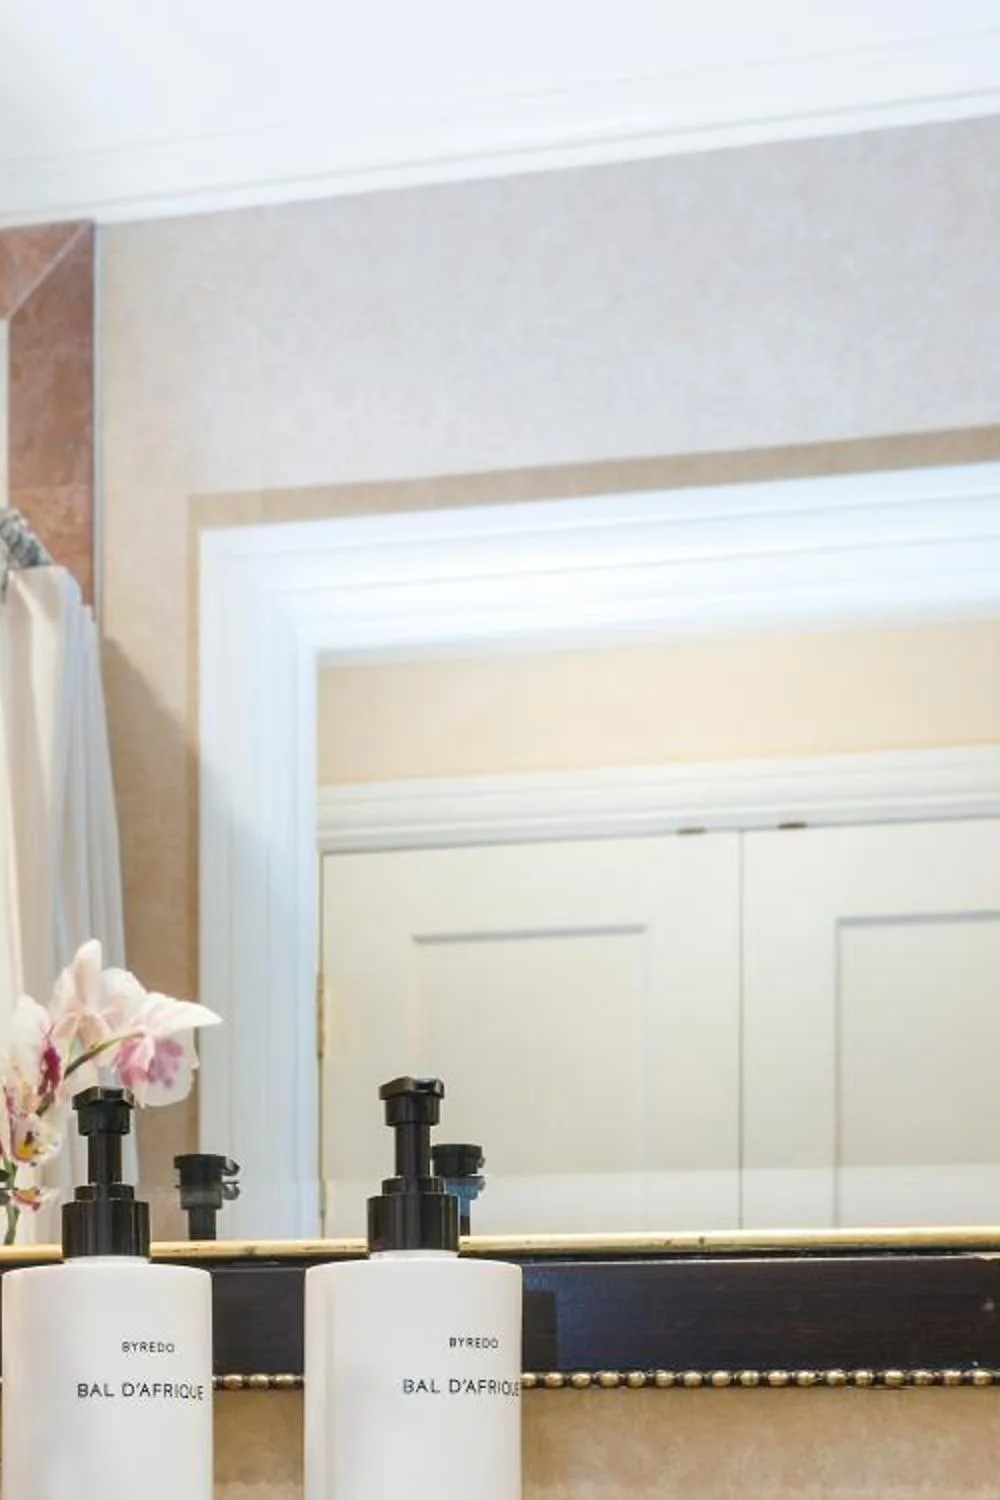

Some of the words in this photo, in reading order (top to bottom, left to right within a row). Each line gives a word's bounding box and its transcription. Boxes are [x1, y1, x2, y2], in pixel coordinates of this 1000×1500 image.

[121, 1341, 175, 1353] BYREDO
[449, 1337, 499, 1349] BYREDO
[77, 1382, 115, 1398] BAL
[403, 1379, 441, 1394] BAL
